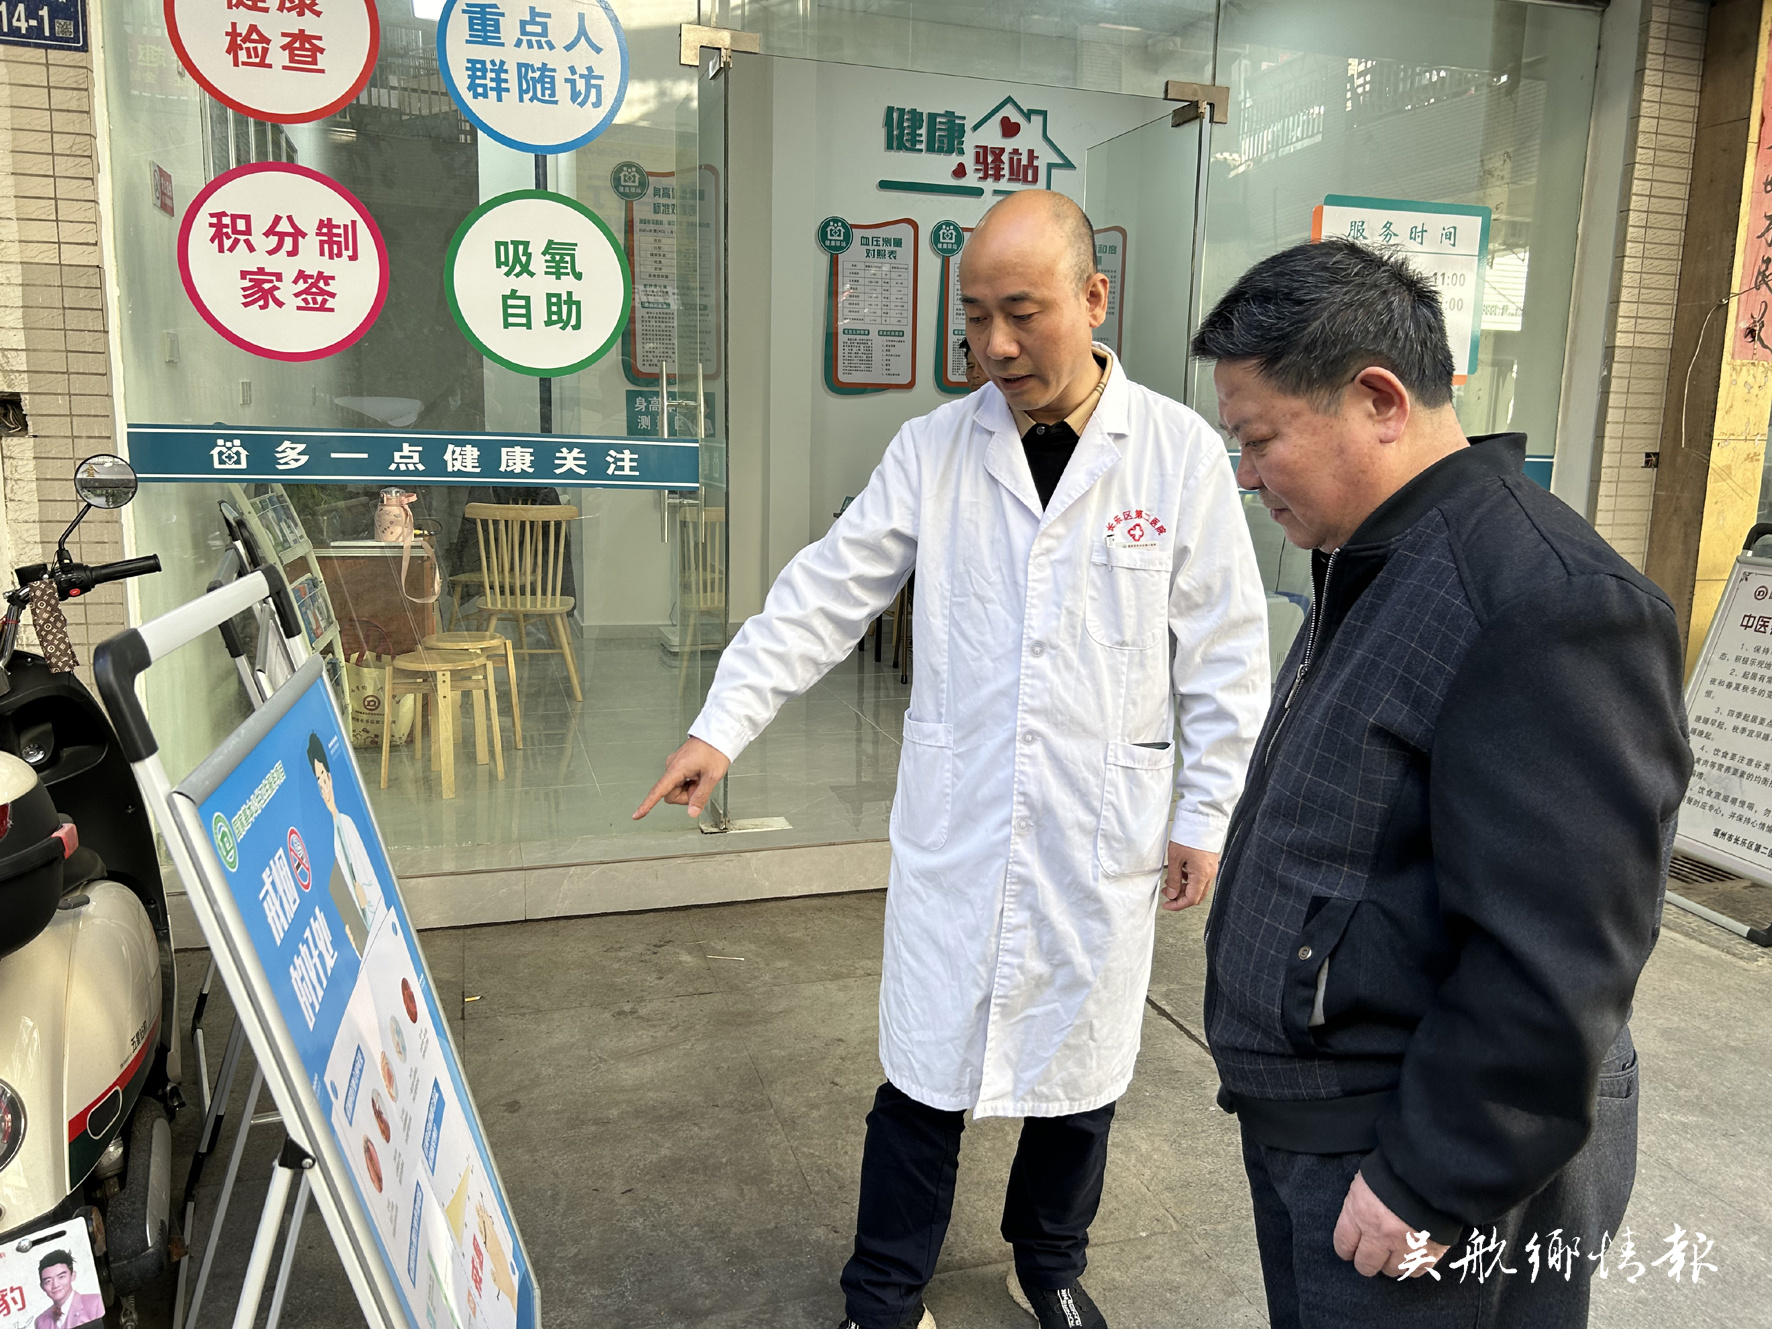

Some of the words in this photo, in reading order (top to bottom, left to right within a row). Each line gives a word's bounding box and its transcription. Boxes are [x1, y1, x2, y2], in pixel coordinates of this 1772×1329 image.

[225, 22, 326, 74] 检查
[461, 3, 604, 55] 重点人
[465, 58, 605, 110] 群随访
[884, 105, 966, 156] 健康
[973, 144, 1040, 184] 驿站
[208, 209, 359, 262] 积分制
[860, 235, 903, 248] 血压测量
[864, 248, 898, 260] 对照表
[1347, 219, 1459, 248] 服务时间
[494, 238, 584, 282] 吸氧
[239, 267, 338, 314] 家签
[501, 289, 583, 332] 自助
[274, 440, 640, 477] 多一点健康关注
[1740, 613, 1772, 635] 中医
[1740, 642, 1772, 657] 1、保持
